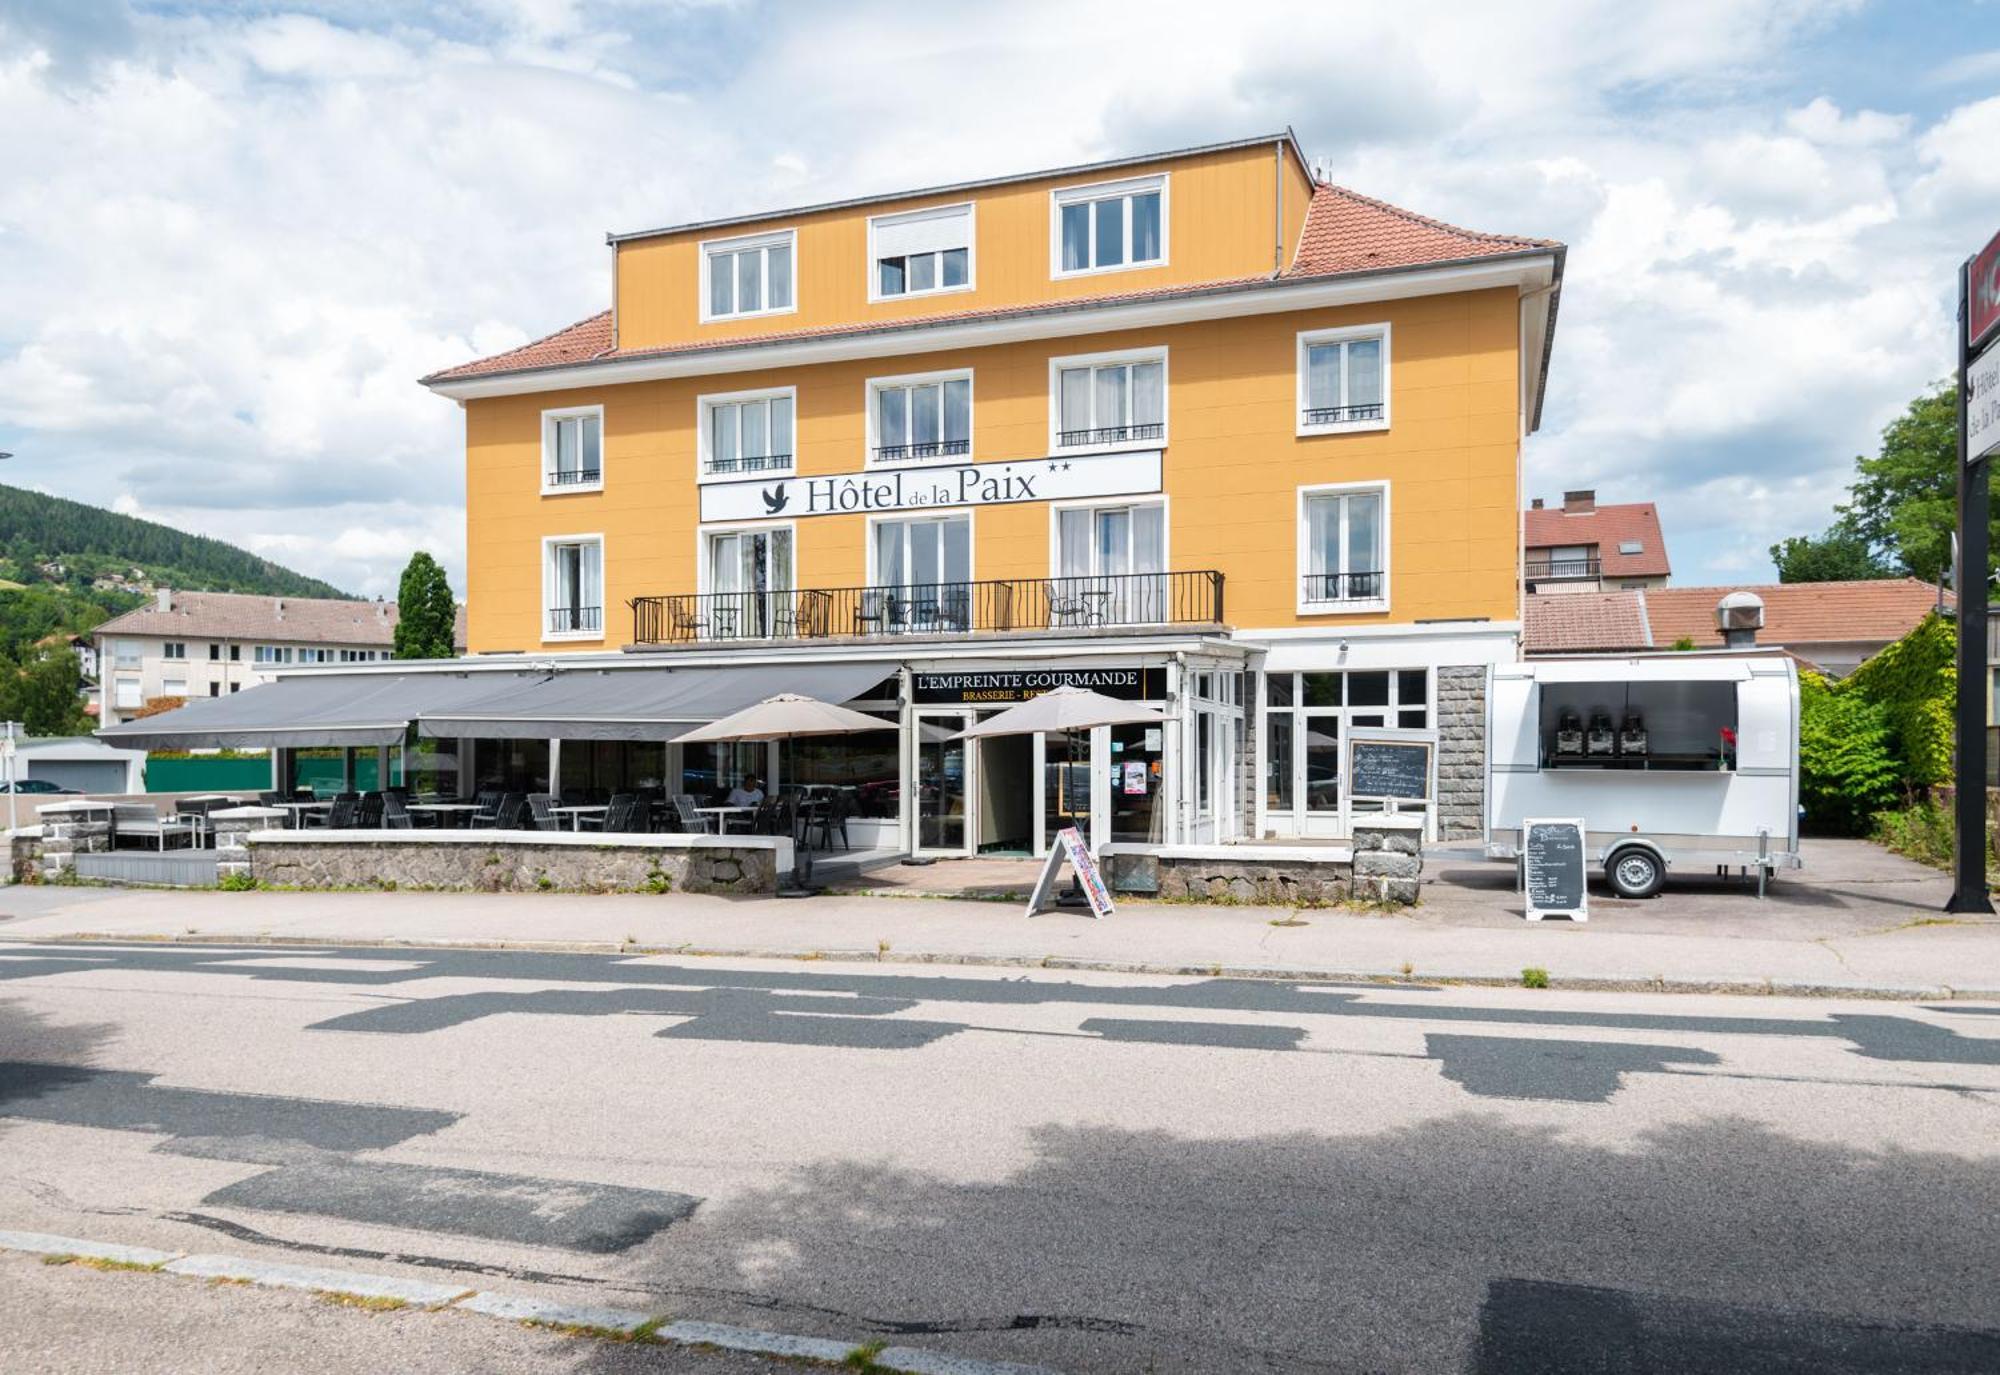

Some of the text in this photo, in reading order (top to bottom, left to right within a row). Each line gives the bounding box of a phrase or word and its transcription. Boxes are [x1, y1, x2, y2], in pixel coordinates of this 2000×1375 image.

[1976, 360, 1999, 399] Hôtel
[1969, 413, 1980, 438] de
[1981, 407, 1990, 430] la
[806, 466, 1038, 513] Hôtel de la Paix
[918, 671, 1138, 689] L'EMPREINTE GOURMANDE
[963, 690, 1015, 701] BRASSERIE
